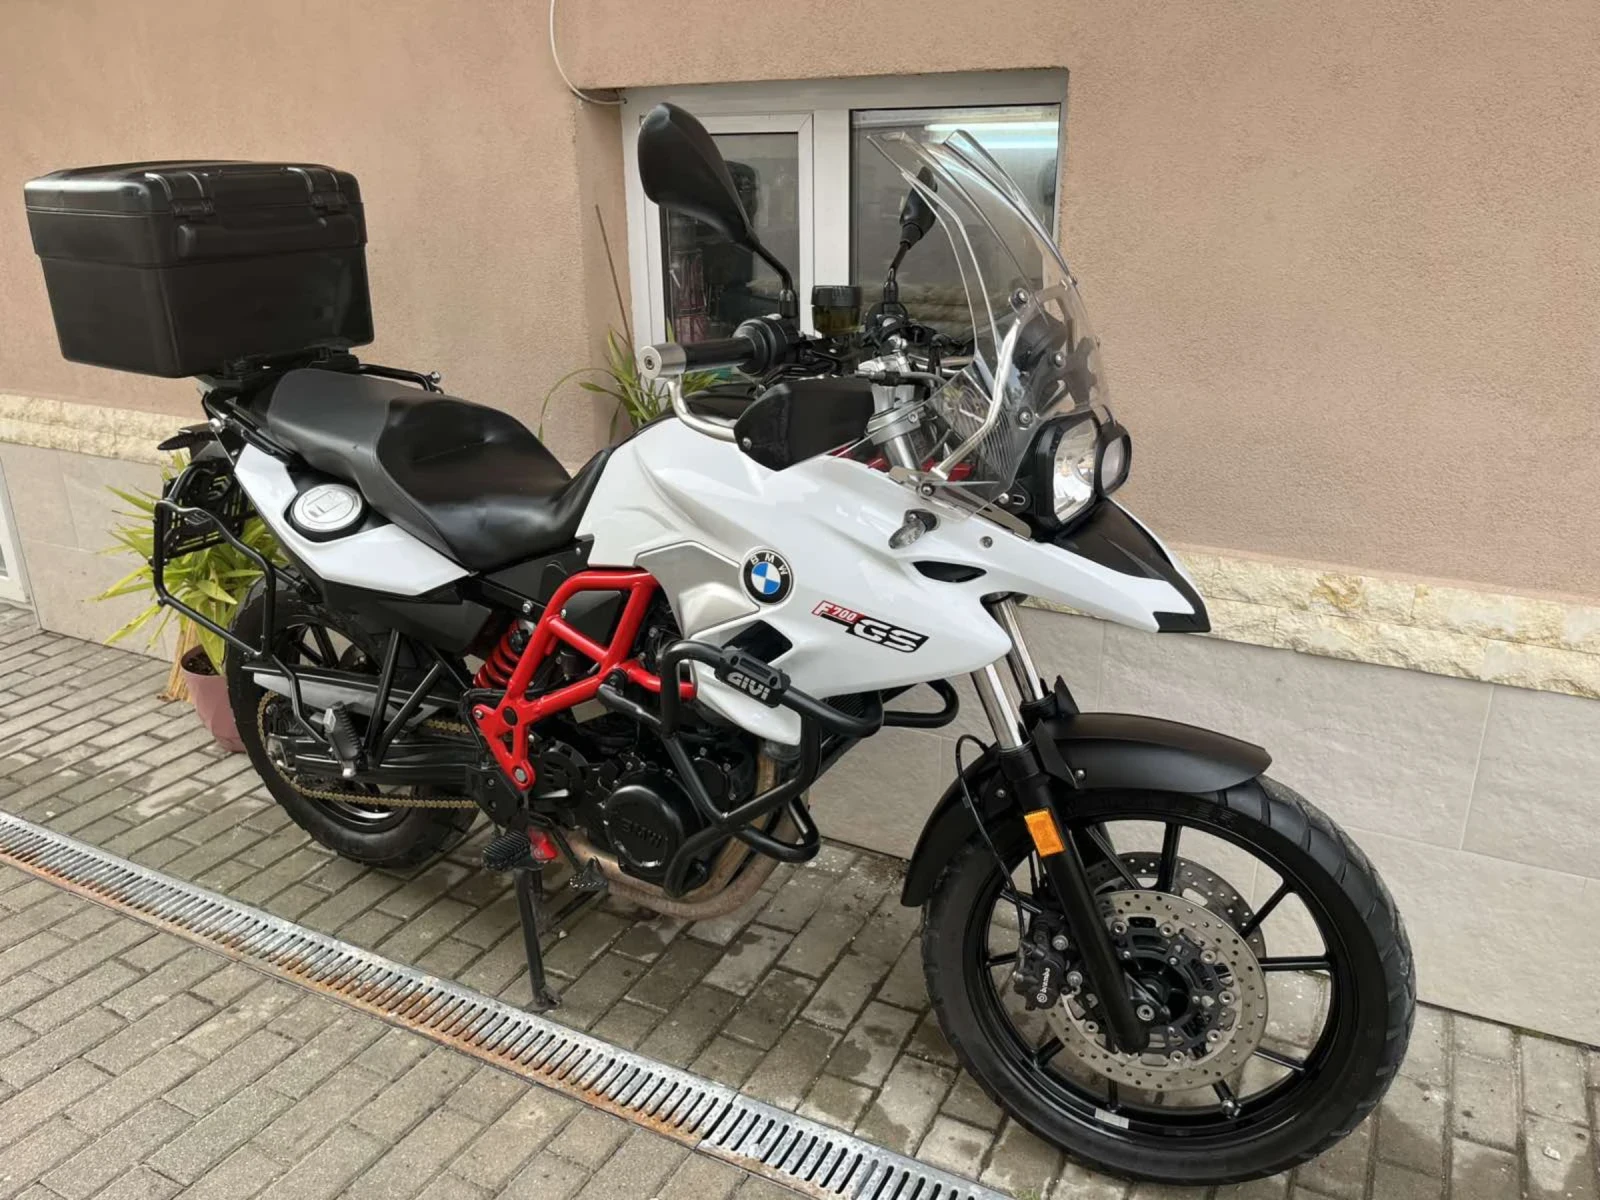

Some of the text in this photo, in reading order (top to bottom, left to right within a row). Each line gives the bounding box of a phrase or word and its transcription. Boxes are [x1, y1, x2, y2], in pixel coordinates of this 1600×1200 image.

[750, 552, 788, 576] BMW
[853, 617, 925, 652] GS
[728, 671, 771, 700] GIVI
